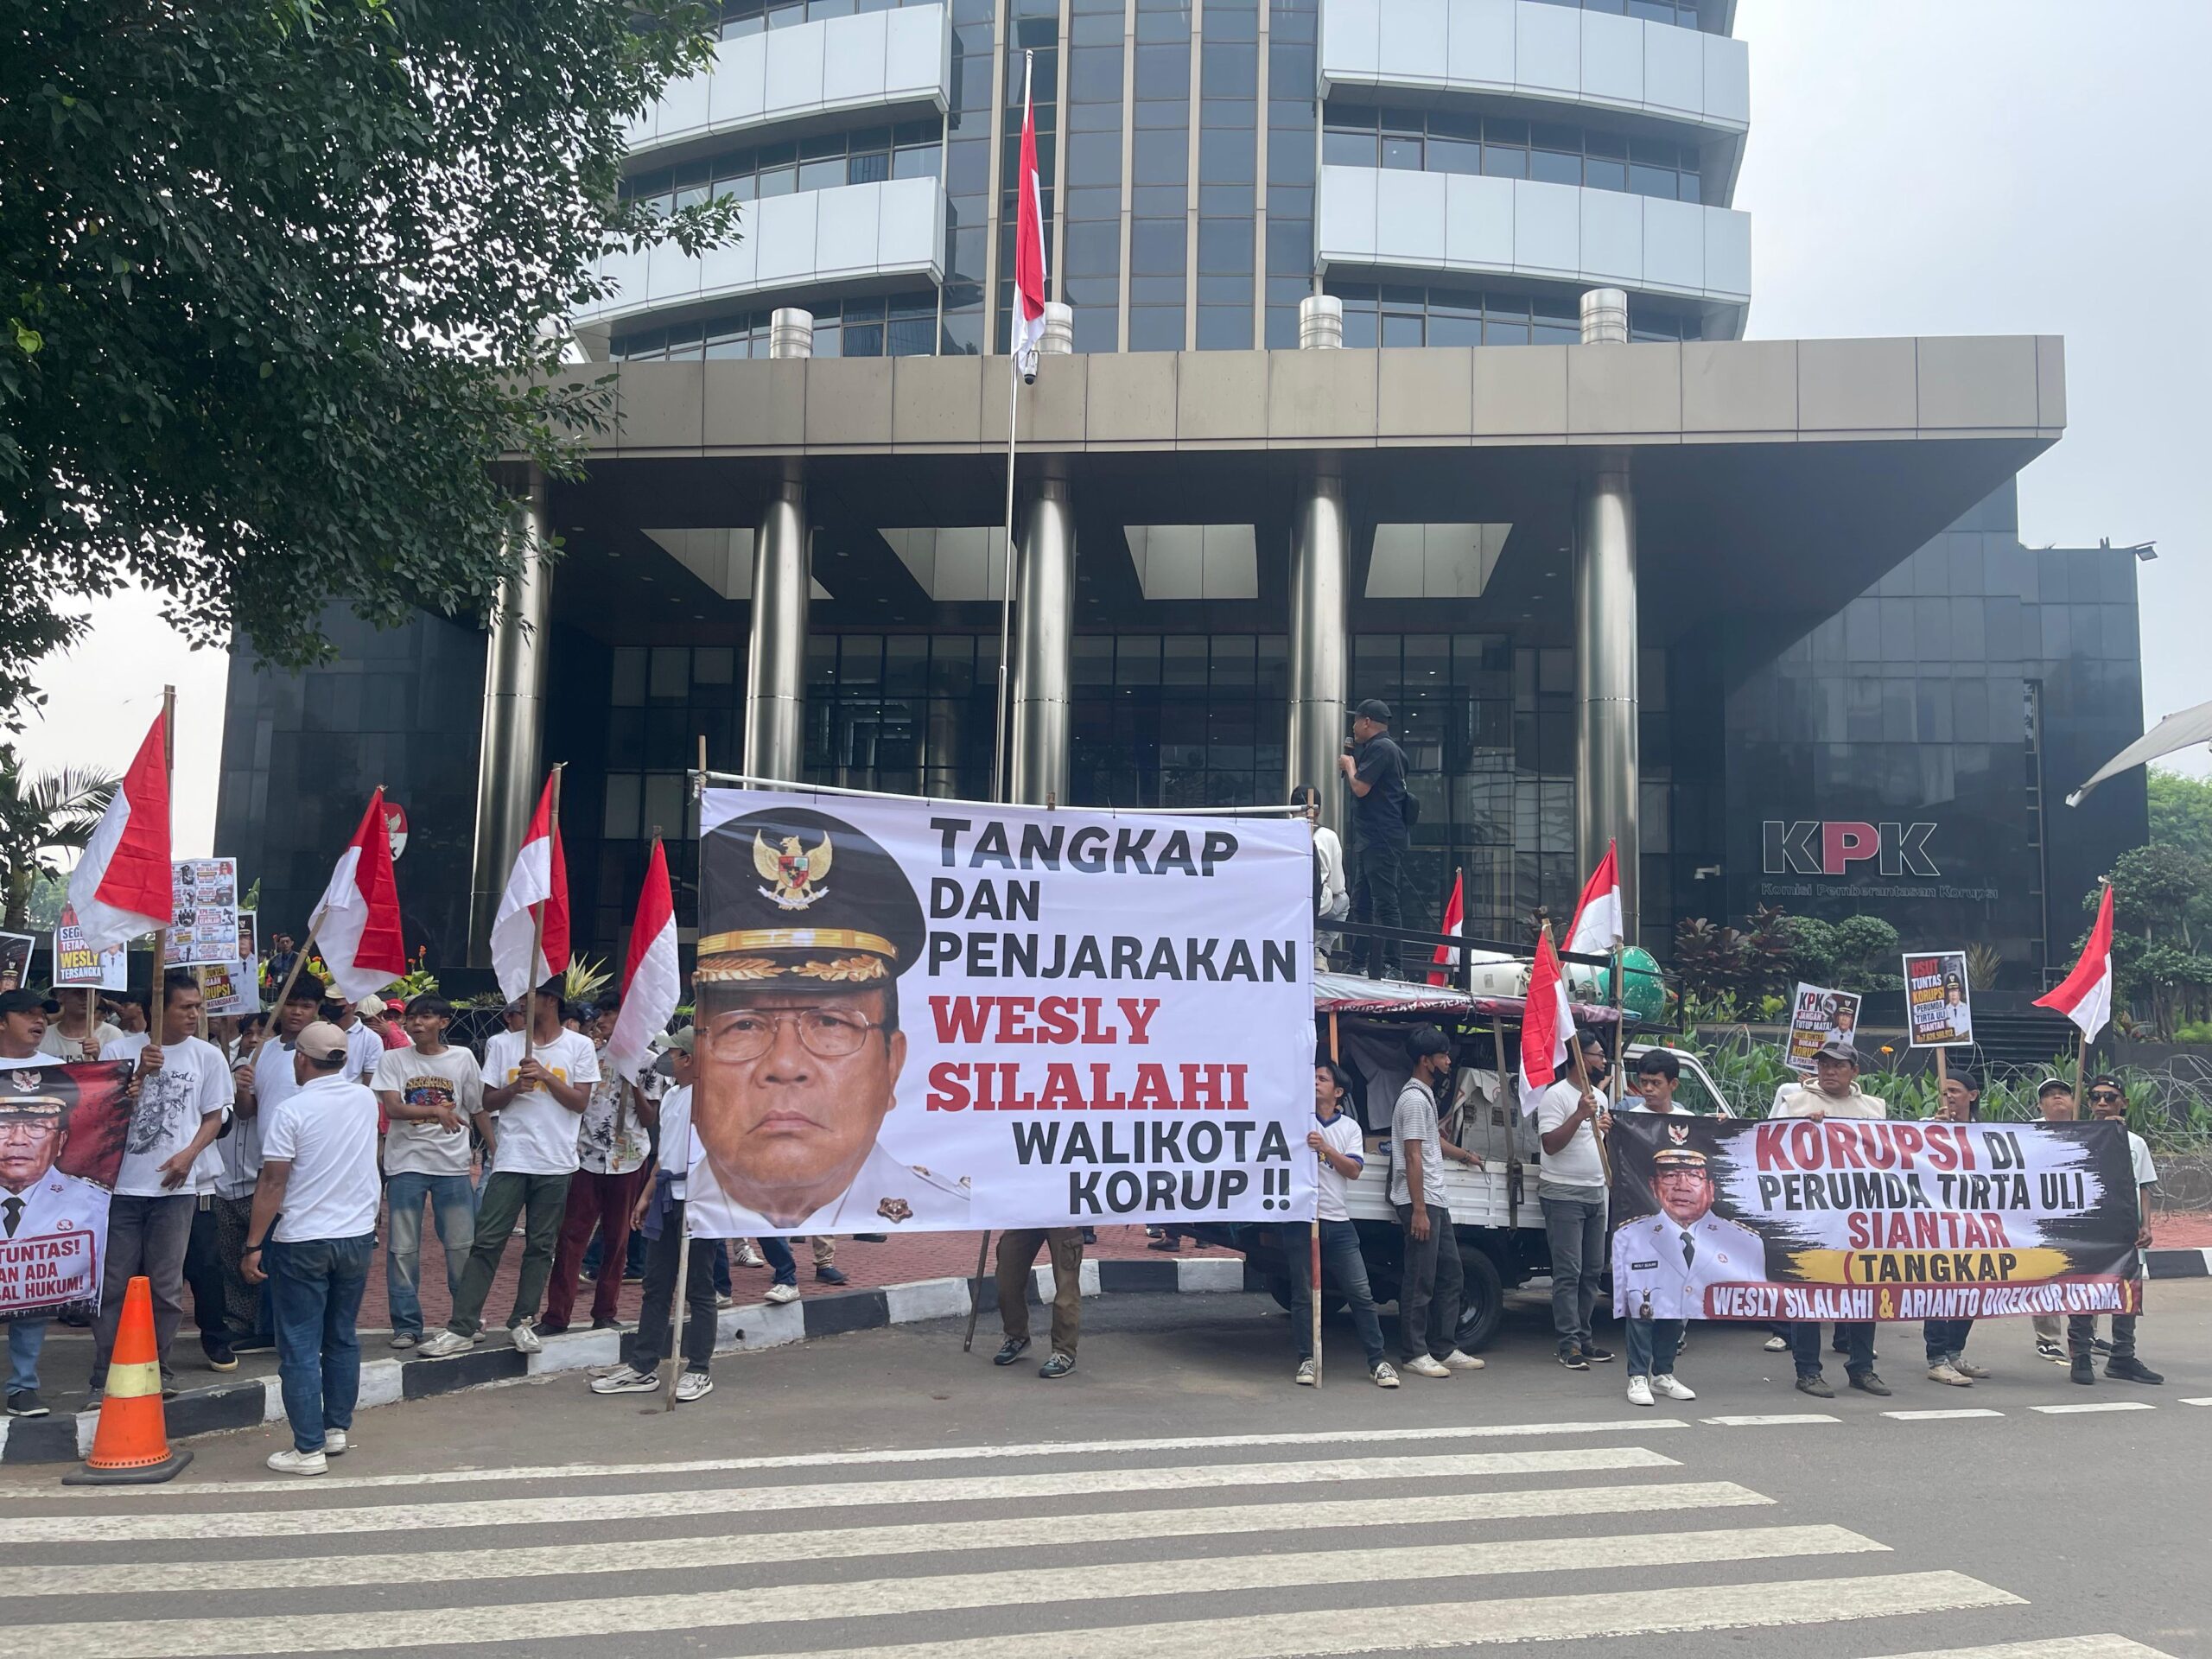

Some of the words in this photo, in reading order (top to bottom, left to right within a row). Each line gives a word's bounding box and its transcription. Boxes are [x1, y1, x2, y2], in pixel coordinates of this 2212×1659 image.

[930, 817, 1239, 877] TANGKAP
[1763, 820, 1941, 876] KPK
[930, 877, 1040, 921] DAN
[1761, 882, 1812, 896] Komisi
[1816, 883, 1936, 898] Pemberantasan
[1939, 885, 1999, 900] Korupsi
[928, 931, 1296, 982] PENJARAKAN
[1910, 958, 1939, 977] USUT
[60, 967, 101, 979] TERSANGKA
[1911, 973, 1942, 990] TUNTAS
[1798, 992, 1825, 1012] KPK
[1912, 986, 1945, 1004] KORUPSI
[1916, 1001, 1943, 1013] PERUMDA
[928, 995, 1160, 1044] WESLY
[1796, 1020, 1814, 1029] TUTUP
[1814, 1021, 1832, 1031] MATA!
[1798, 1012, 1822, 1021] JANGAN
[1916, 1013, 1935, 1023] TIRTA
[1936, 1011, 1946, 1020] ULI
[1919, 1020, 1945, 1033] SIANTAR
[926, 1062, 1249, 1112] SILALAHI
[1012, 1120, 1293, 1165] WALIKOTA
[1755, 1122, 1975, 1172] KORUPSI
[1983, 1131, 2024, 1170] DI
[1070, 1168, 1249, 1215] KORUP
[1262, 1168, 1290, 1211] !!
[1758, 1173, 1930, 1211] PERUMDA
[1937, 1173, 2031, 1211] TIRTA
[2039, 1173, 2085, 1211] ULI
[1848, 1211, 2011, 1249] SIANTAR
[25, 1262, 58, 1281] ADA
[25, 1275, 83, 1299] HUKUM!
[1713, 1287, 1779, 1318] WESLY
[1784, 1287, 1873, 1319] SILALAHI
[1878, 1287, 1895, 1319] &
[1899, 1287, 1980, 1319] ARIANTO
[1982, 1283, 2067, 1316] DIREKTUR
